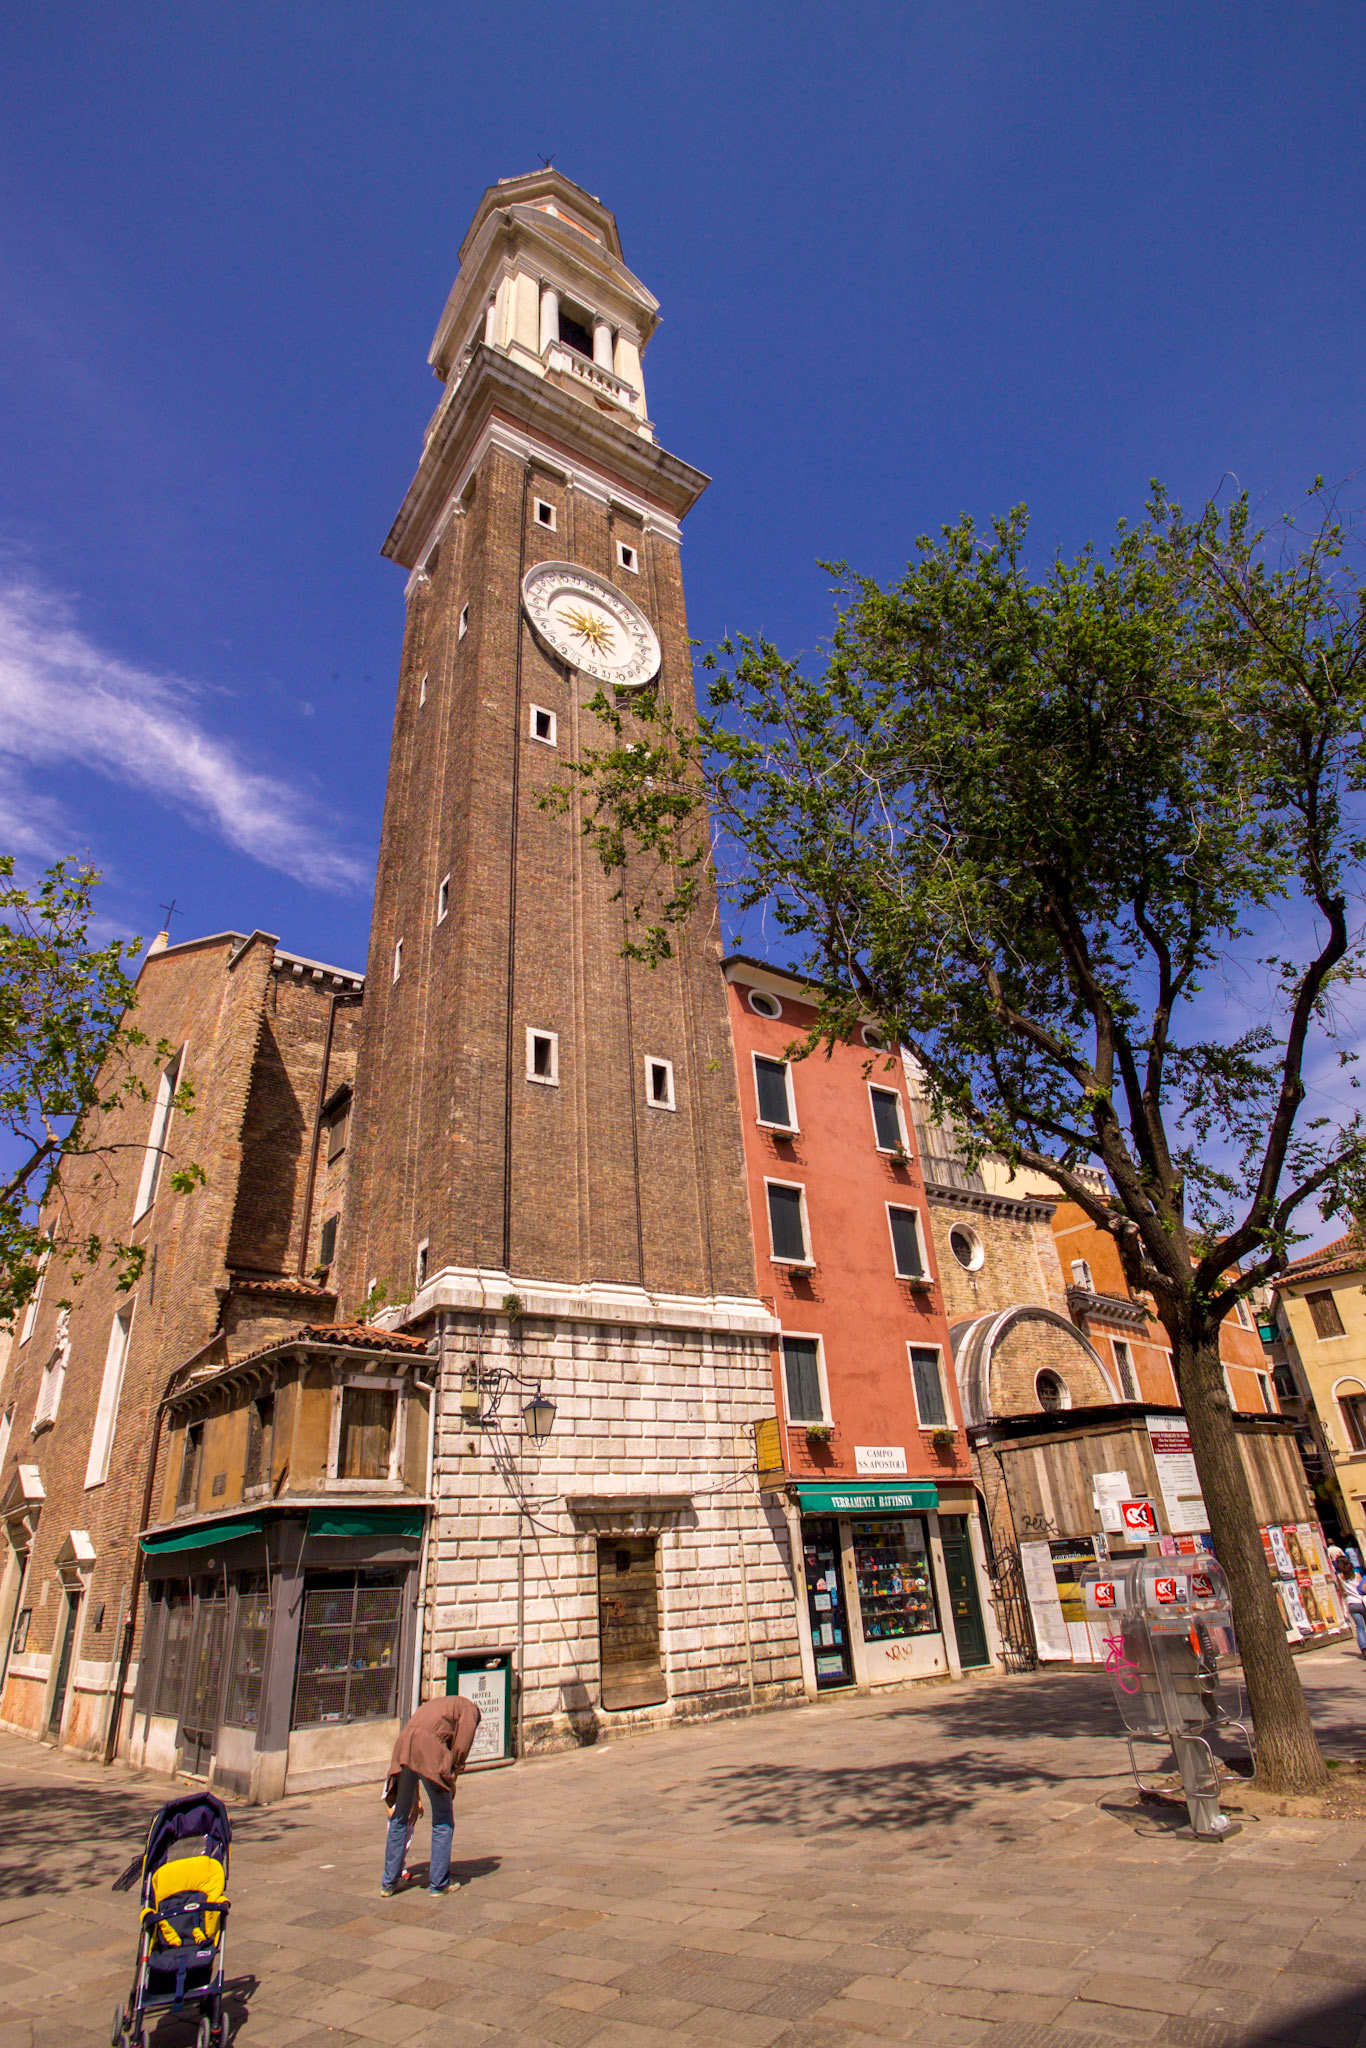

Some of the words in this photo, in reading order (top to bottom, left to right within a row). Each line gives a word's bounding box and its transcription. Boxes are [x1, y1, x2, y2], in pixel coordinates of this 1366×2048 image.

[561, 646, 568, 655] 2
[588, 664, 598, 675] 12
[615, 671, 626, 681] 10
[866, 1449, 893, 1458] CAMPO
[472, 1691, 492, 1699] HOTEL
